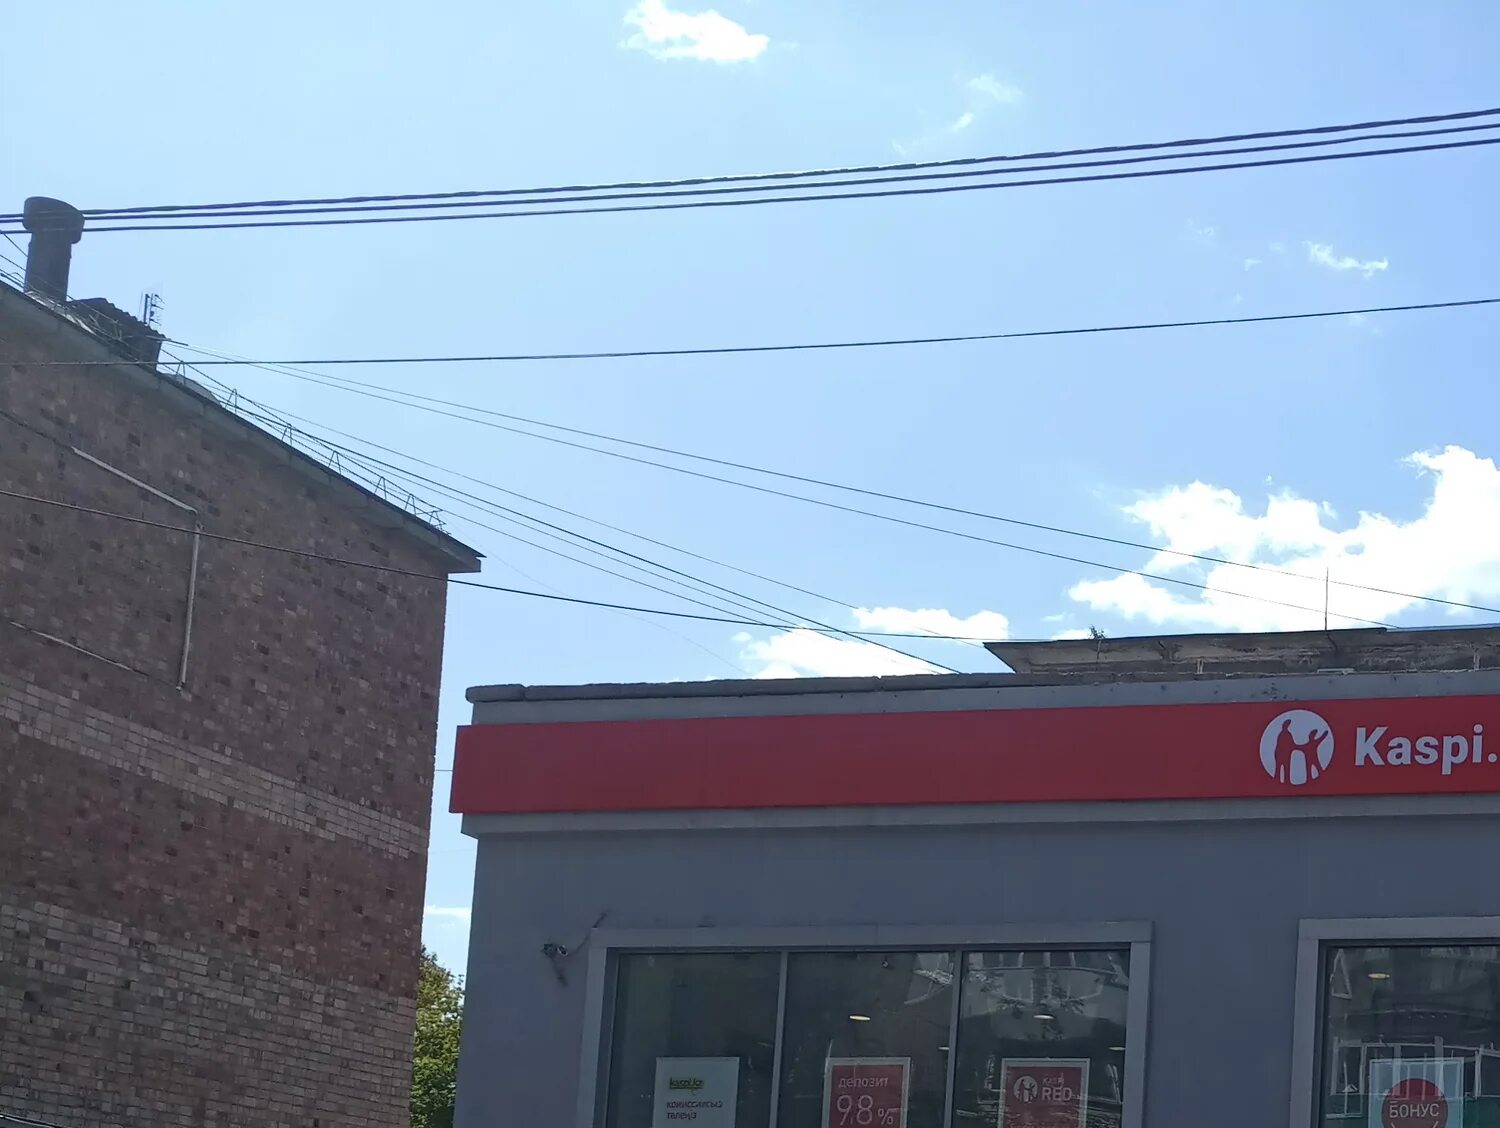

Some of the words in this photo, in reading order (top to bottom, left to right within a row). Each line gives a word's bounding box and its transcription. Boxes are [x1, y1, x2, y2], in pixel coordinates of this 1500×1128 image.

[838, 1077, 889, 1088] депозит
[1042, 1087, 1072, 1101] RED
[1389, 1102, 1440, 1118] БОНУС
